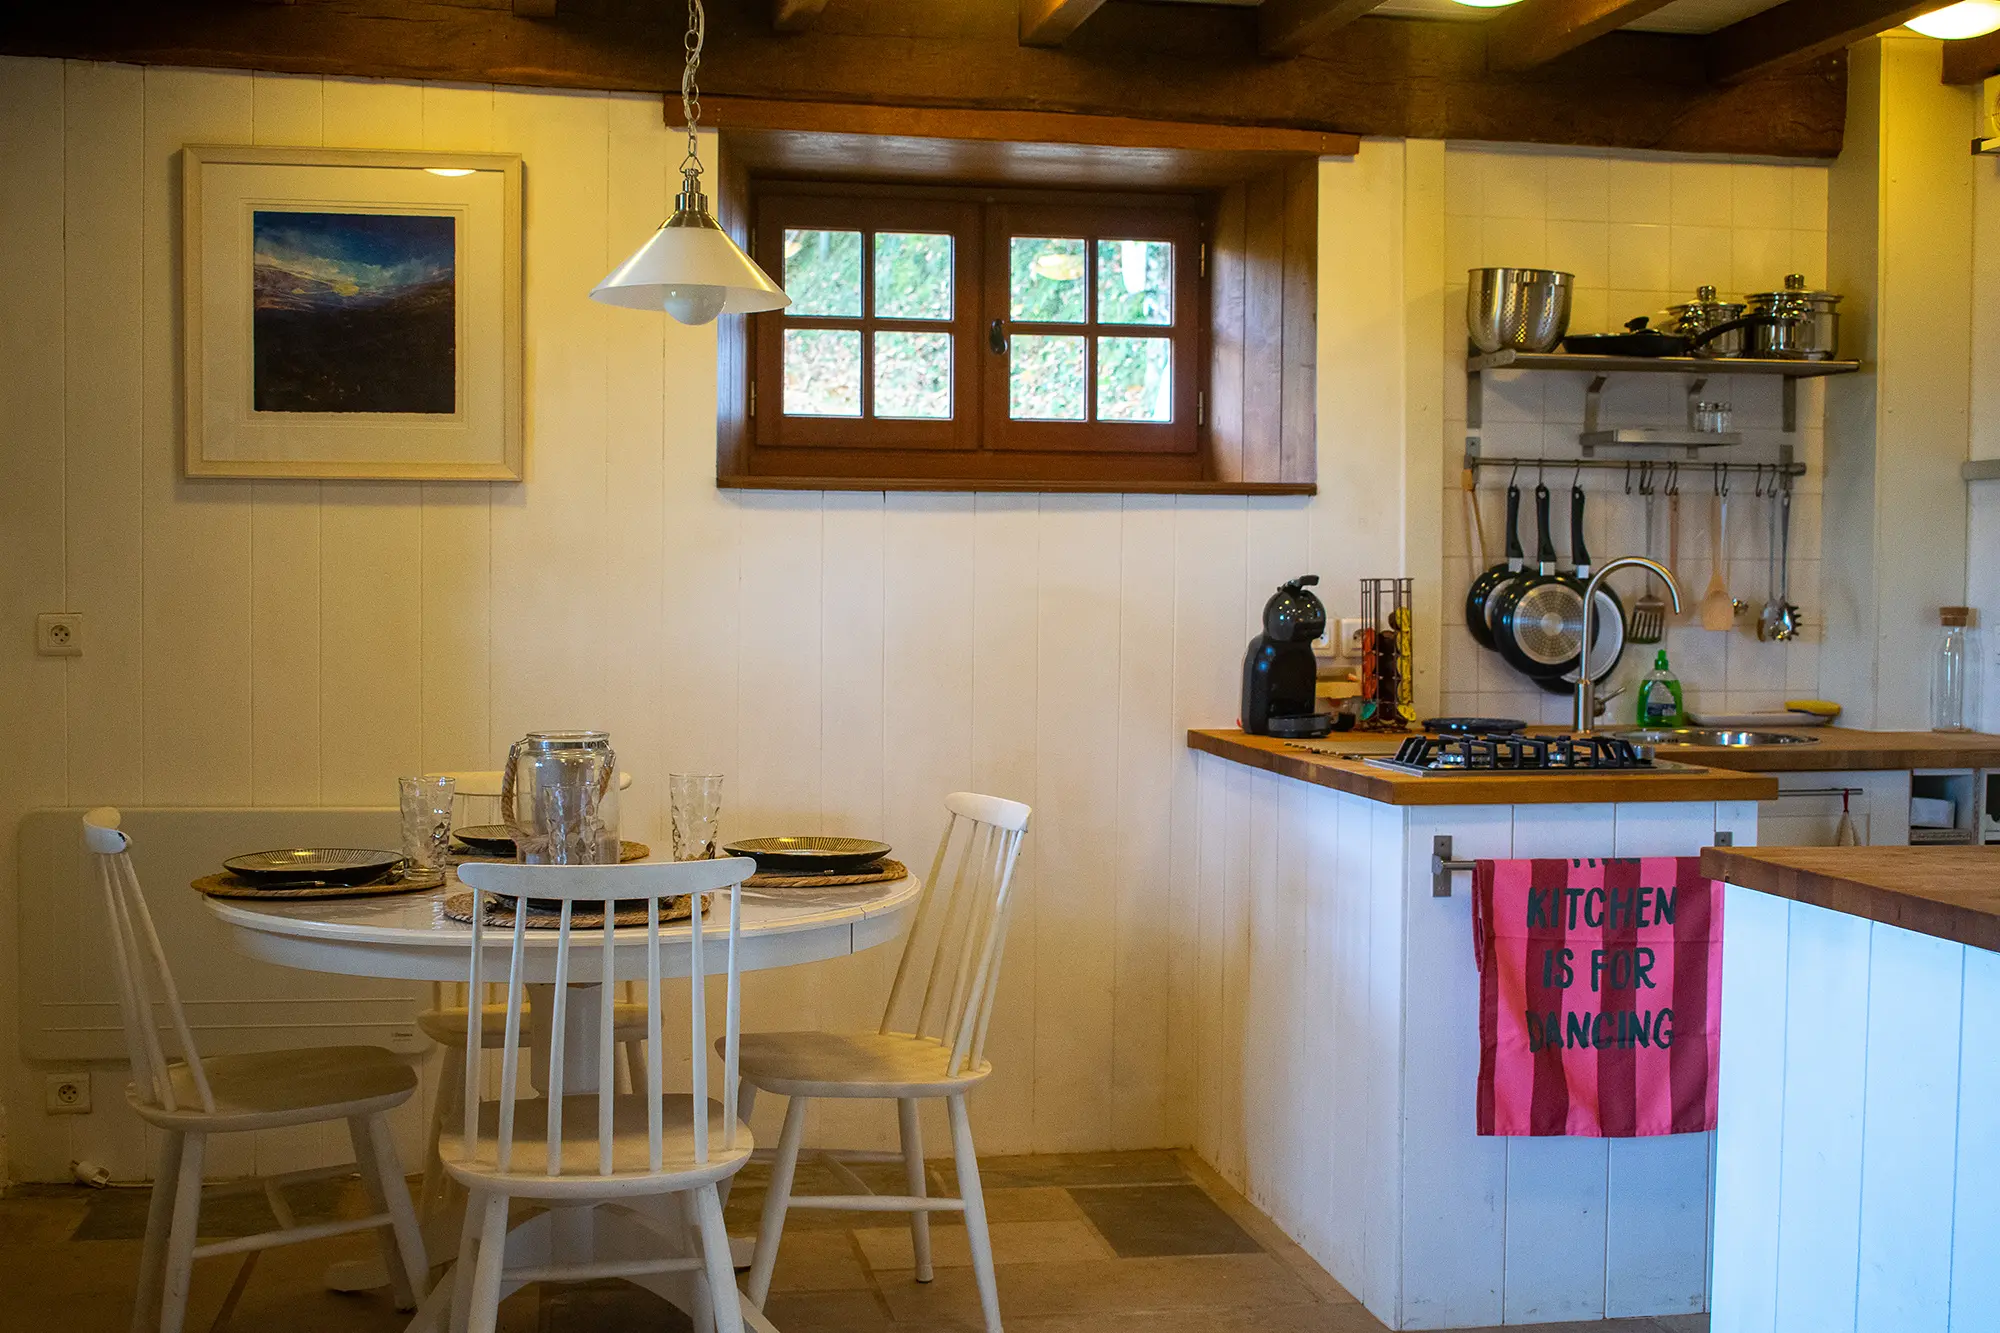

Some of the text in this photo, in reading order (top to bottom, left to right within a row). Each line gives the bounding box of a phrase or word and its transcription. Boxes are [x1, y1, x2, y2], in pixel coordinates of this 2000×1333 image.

[1527, 886, 1677, 930] KITCHEN
[1543, 946, 1656, 992] IS FOR
[1525, 1008, 1675, 1053] DANCING
